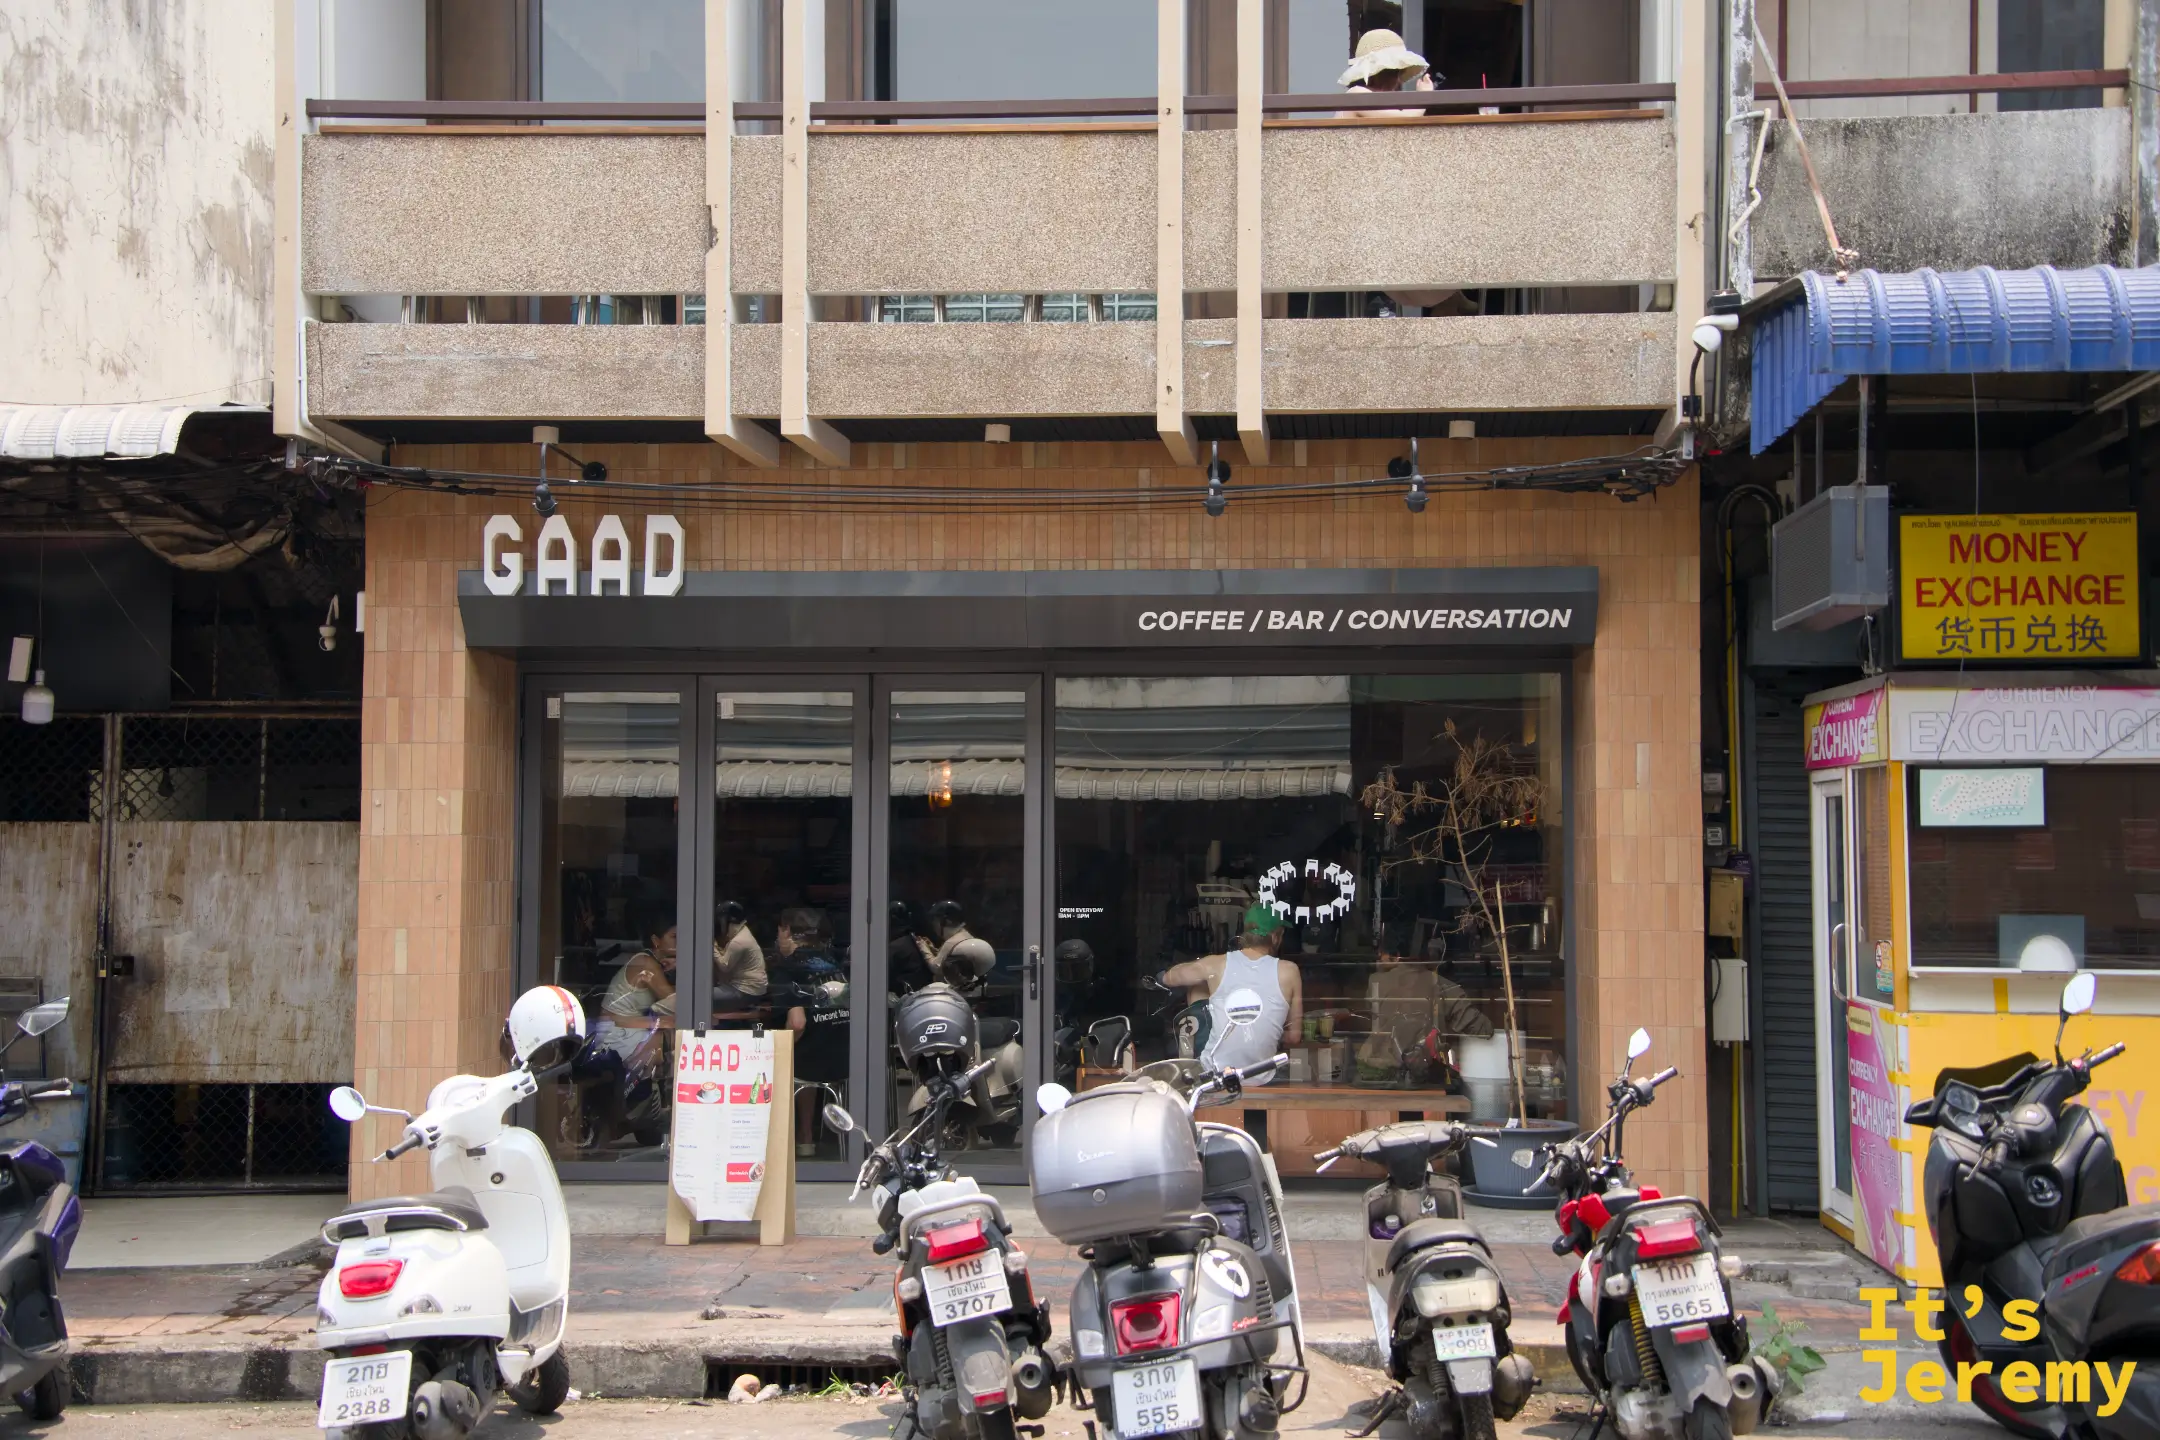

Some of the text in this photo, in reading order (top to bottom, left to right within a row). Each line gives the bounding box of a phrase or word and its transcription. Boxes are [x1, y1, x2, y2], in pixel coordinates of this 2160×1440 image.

[484, 514, 685, 597] GAAD
[1949, 531, 2088, 564] MONEY
[1915, 574, 2126, 608] EXCHANGE
[1137, 609, 1572, 632] COFFEE / BAR / CONVERSATION
[1935, 613, 2108, 654] 货币兑换
[1811, 713, 1877, 762] EXCHANGE
[680, 1043, 740, 1072] GAAD
[1849, 1057, 1879, 1085] CURRENCY
[1850, 1086, 1897, 1141] EXCHANGE
[945, 1294, 996, 1320] 3707
[1656, 1298, 1713, 1321] 5665
[336, 1398, 391, 1421] 2388
[1137, 1403, 1179, 1427] 555
